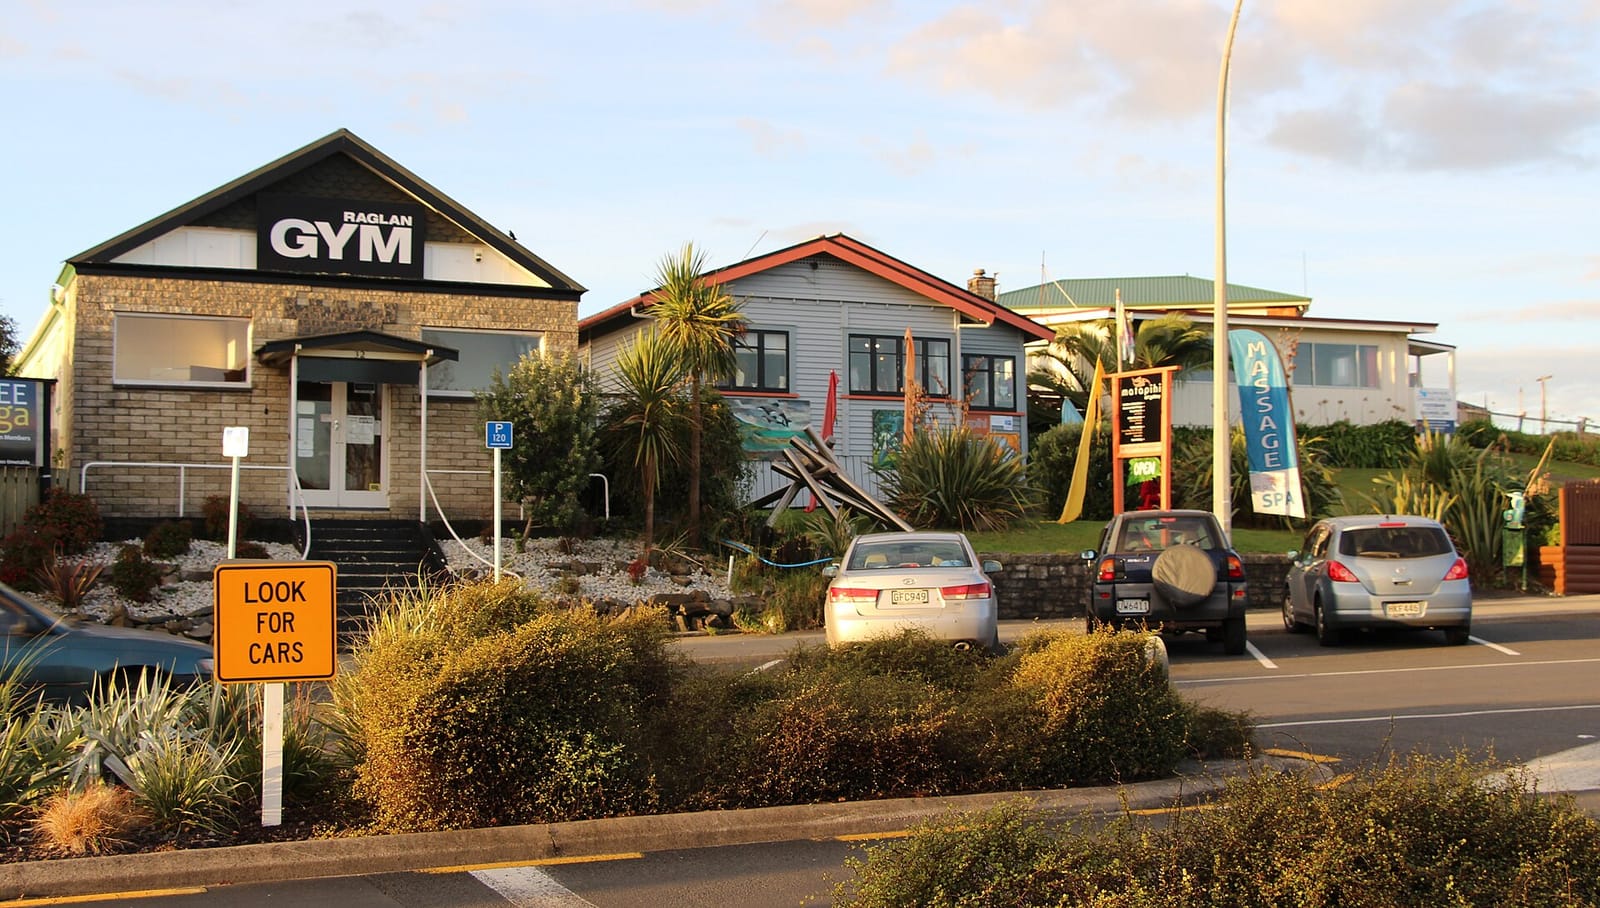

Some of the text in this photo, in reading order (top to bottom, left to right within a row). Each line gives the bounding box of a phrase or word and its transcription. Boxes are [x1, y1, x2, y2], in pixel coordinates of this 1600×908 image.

[343, 211, 413, 226] RAGLAN
[270, 218, 412, 265] GYM
[1247, 340, 1281, 468] MASSAGE
[495, 423, 504, 433] P
[492, 433, 506, 442] 120
[1133, 461, 1156, 476] OPEN
[1262, 490, 1295, 508] SPA
[244, 581, 307, 603] LOOK
[893, 592, 926, 602] GFC949
[257, 611, 295, 634] FOR
[249, 642, 304, 665] CARS
